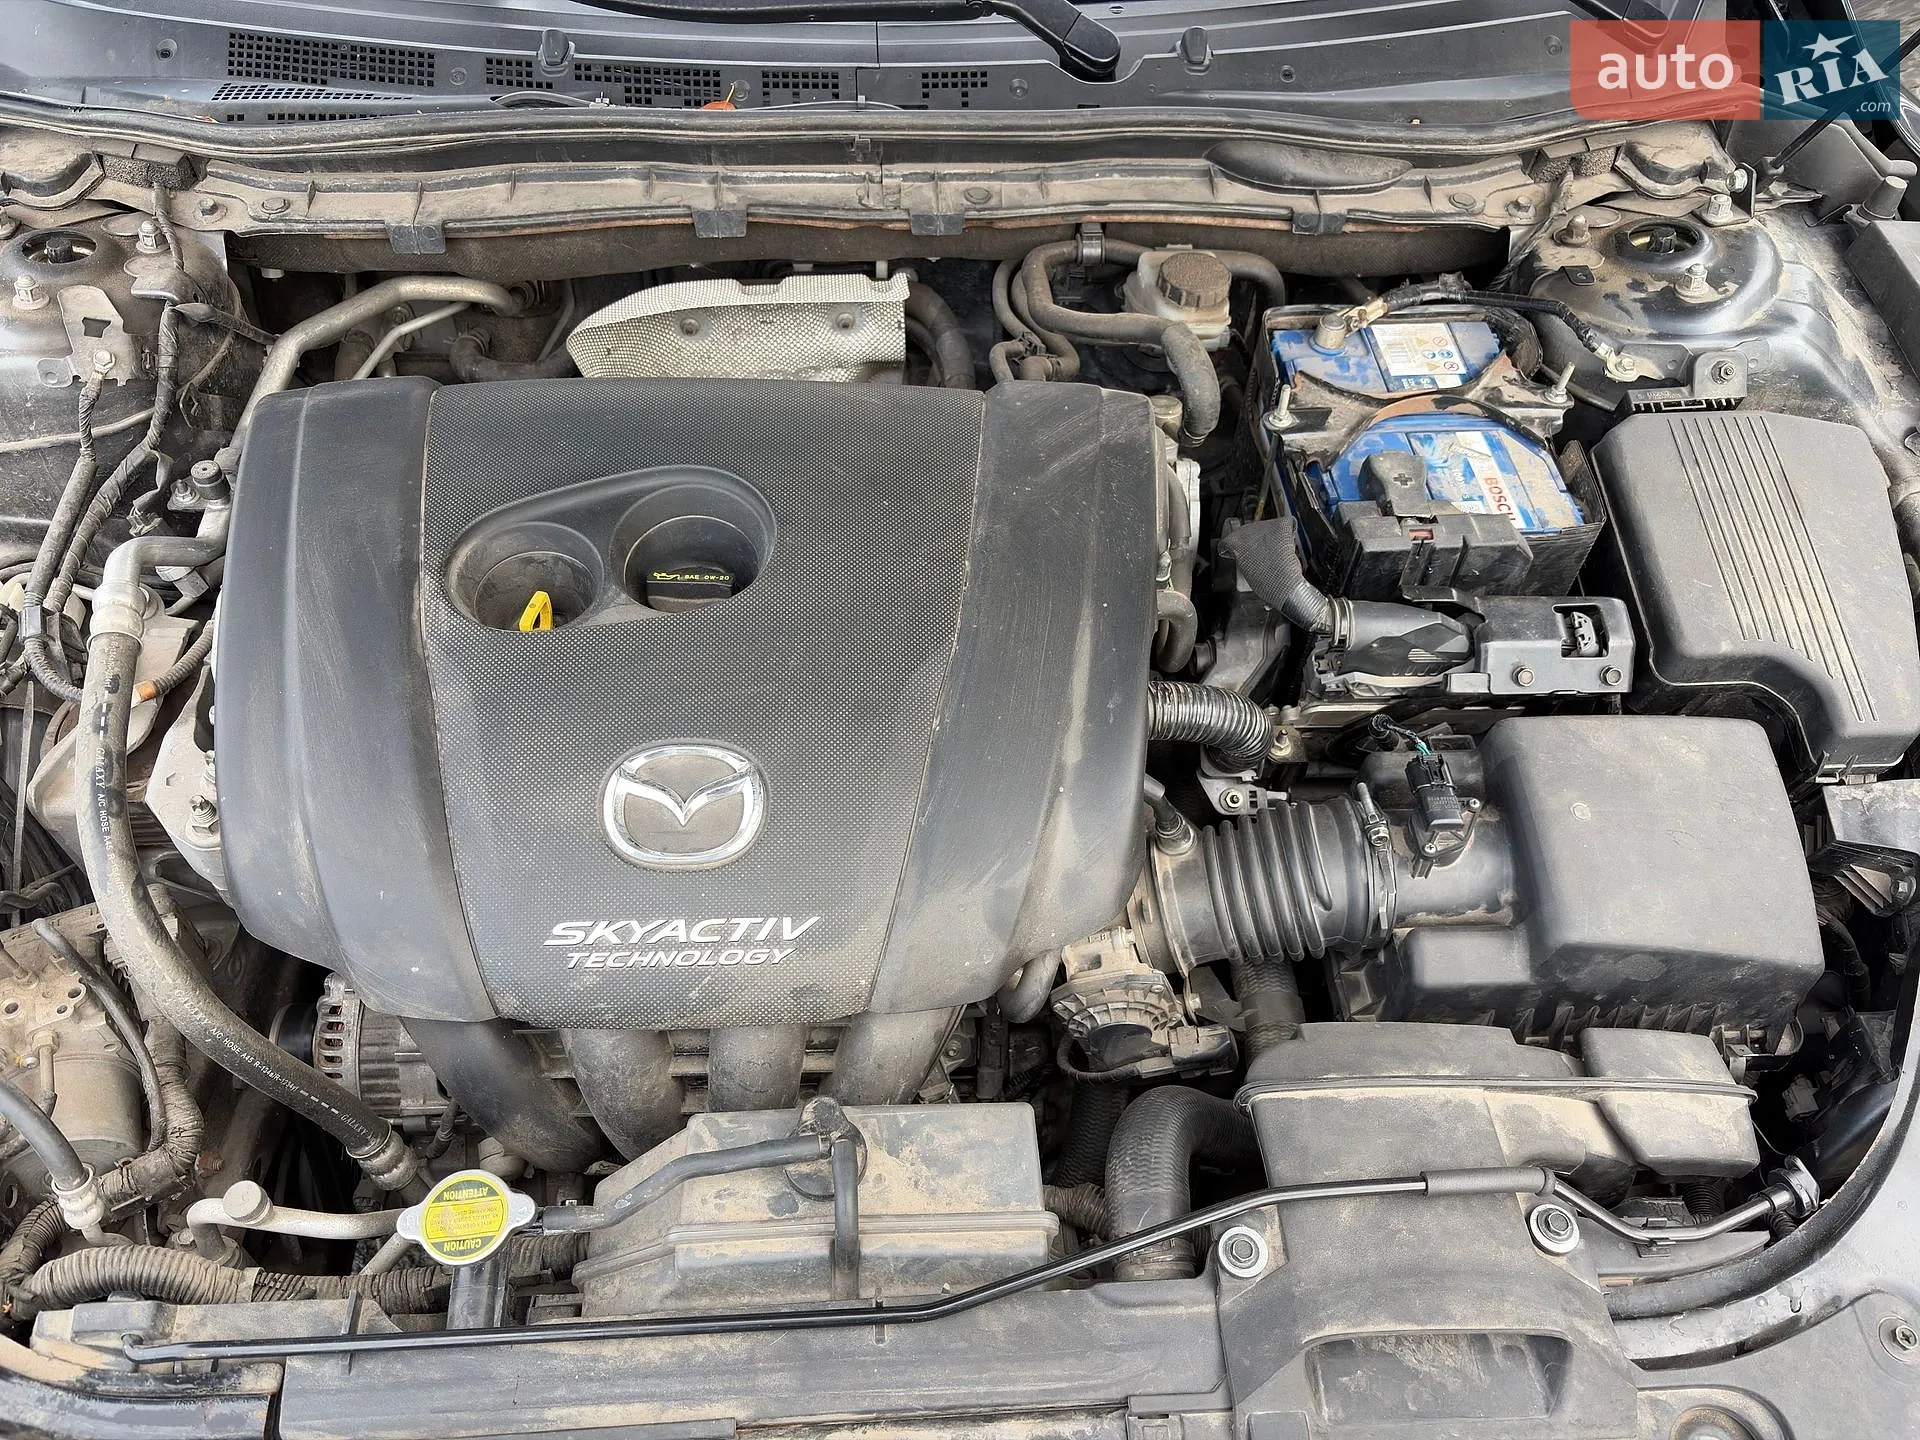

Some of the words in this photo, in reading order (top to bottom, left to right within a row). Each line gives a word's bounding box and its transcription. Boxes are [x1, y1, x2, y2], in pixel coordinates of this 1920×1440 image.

[95, 746, 106, 789] GALAXY
[97, 793, 106, 808] A/C
[99, 809, 110, 833] HOSE
[543, 916, 822, 946] SKYACTIV
[567, 948, 798, 969] TECHNOLOGY
[210, 1027, 224, 1039] A/C
[222, 1037, 242, 1055] HOSE
[443, 1187, 489, 1201] ATTENTION
[443, 1238, 482, 1252] CAUTION
